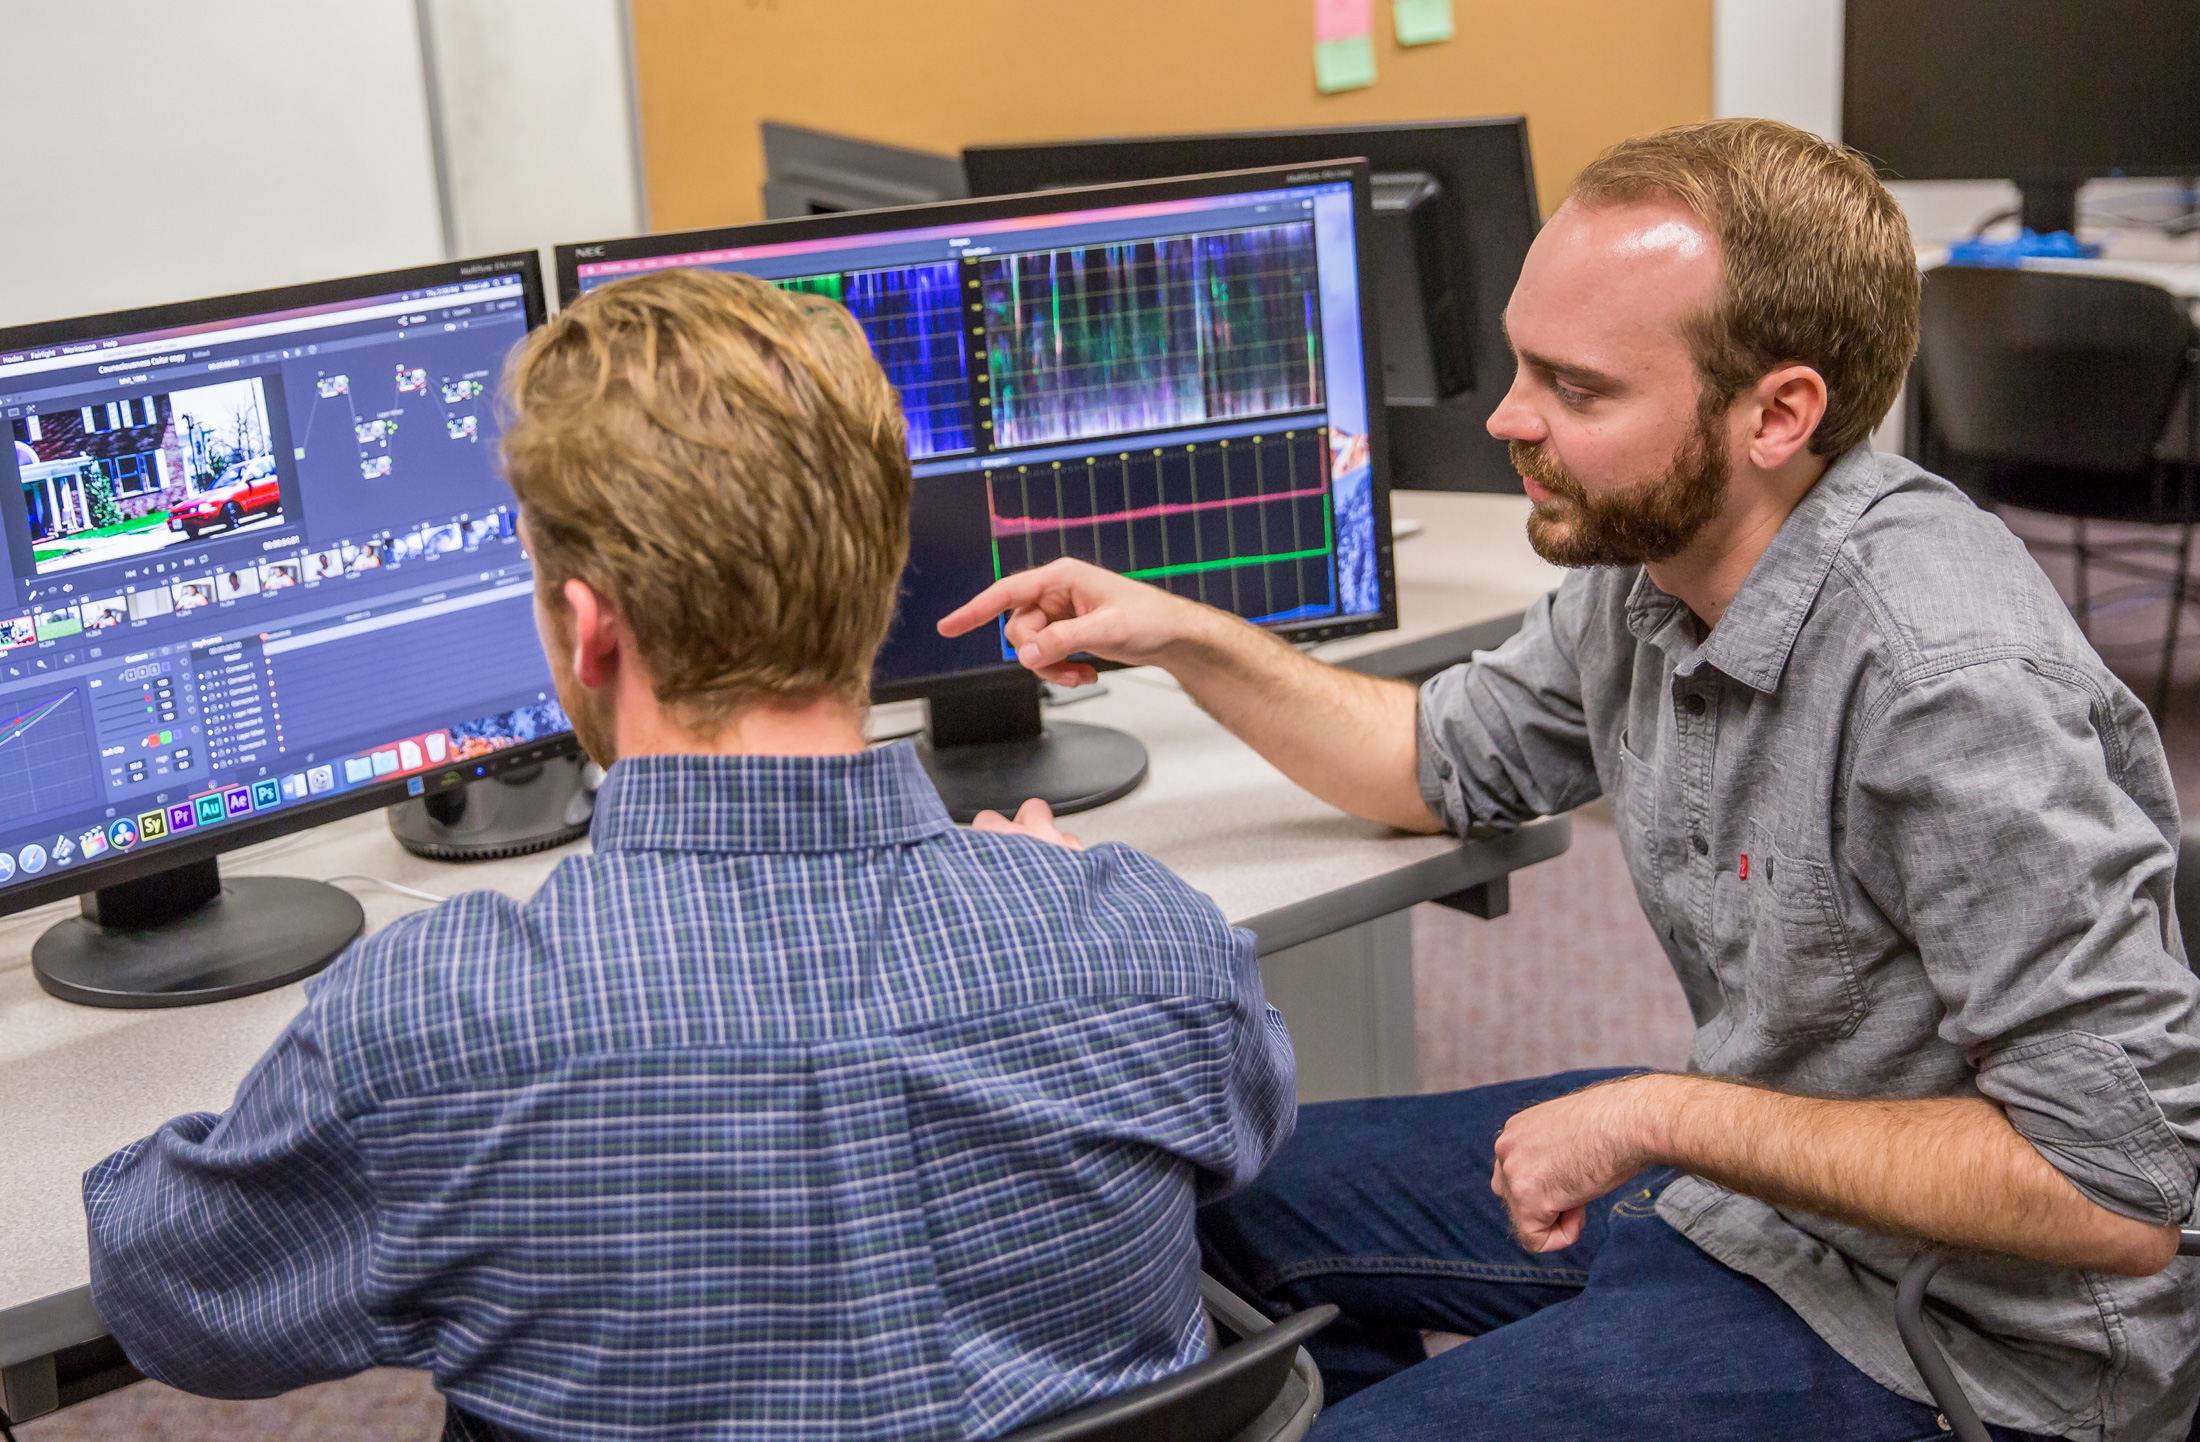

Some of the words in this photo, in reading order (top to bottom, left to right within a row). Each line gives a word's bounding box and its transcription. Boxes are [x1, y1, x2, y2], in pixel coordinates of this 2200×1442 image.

[575, 246, 606, 258] NEC
[3, 355, 24, 364] Nodes
[31, 350, 56, 360] Fairlight
[62, 343, 97, 354] Workspace
[103, 340, 119, 349] Help
[169, 353, 186, 364] copy
[258, 786, 275, 801] Ps
[202, 802, 220, 818] Au
[230, 795, 248, 810] Ae
[174, 810, 190, 824] Pr
[144, 817, 161, 834] Sy
